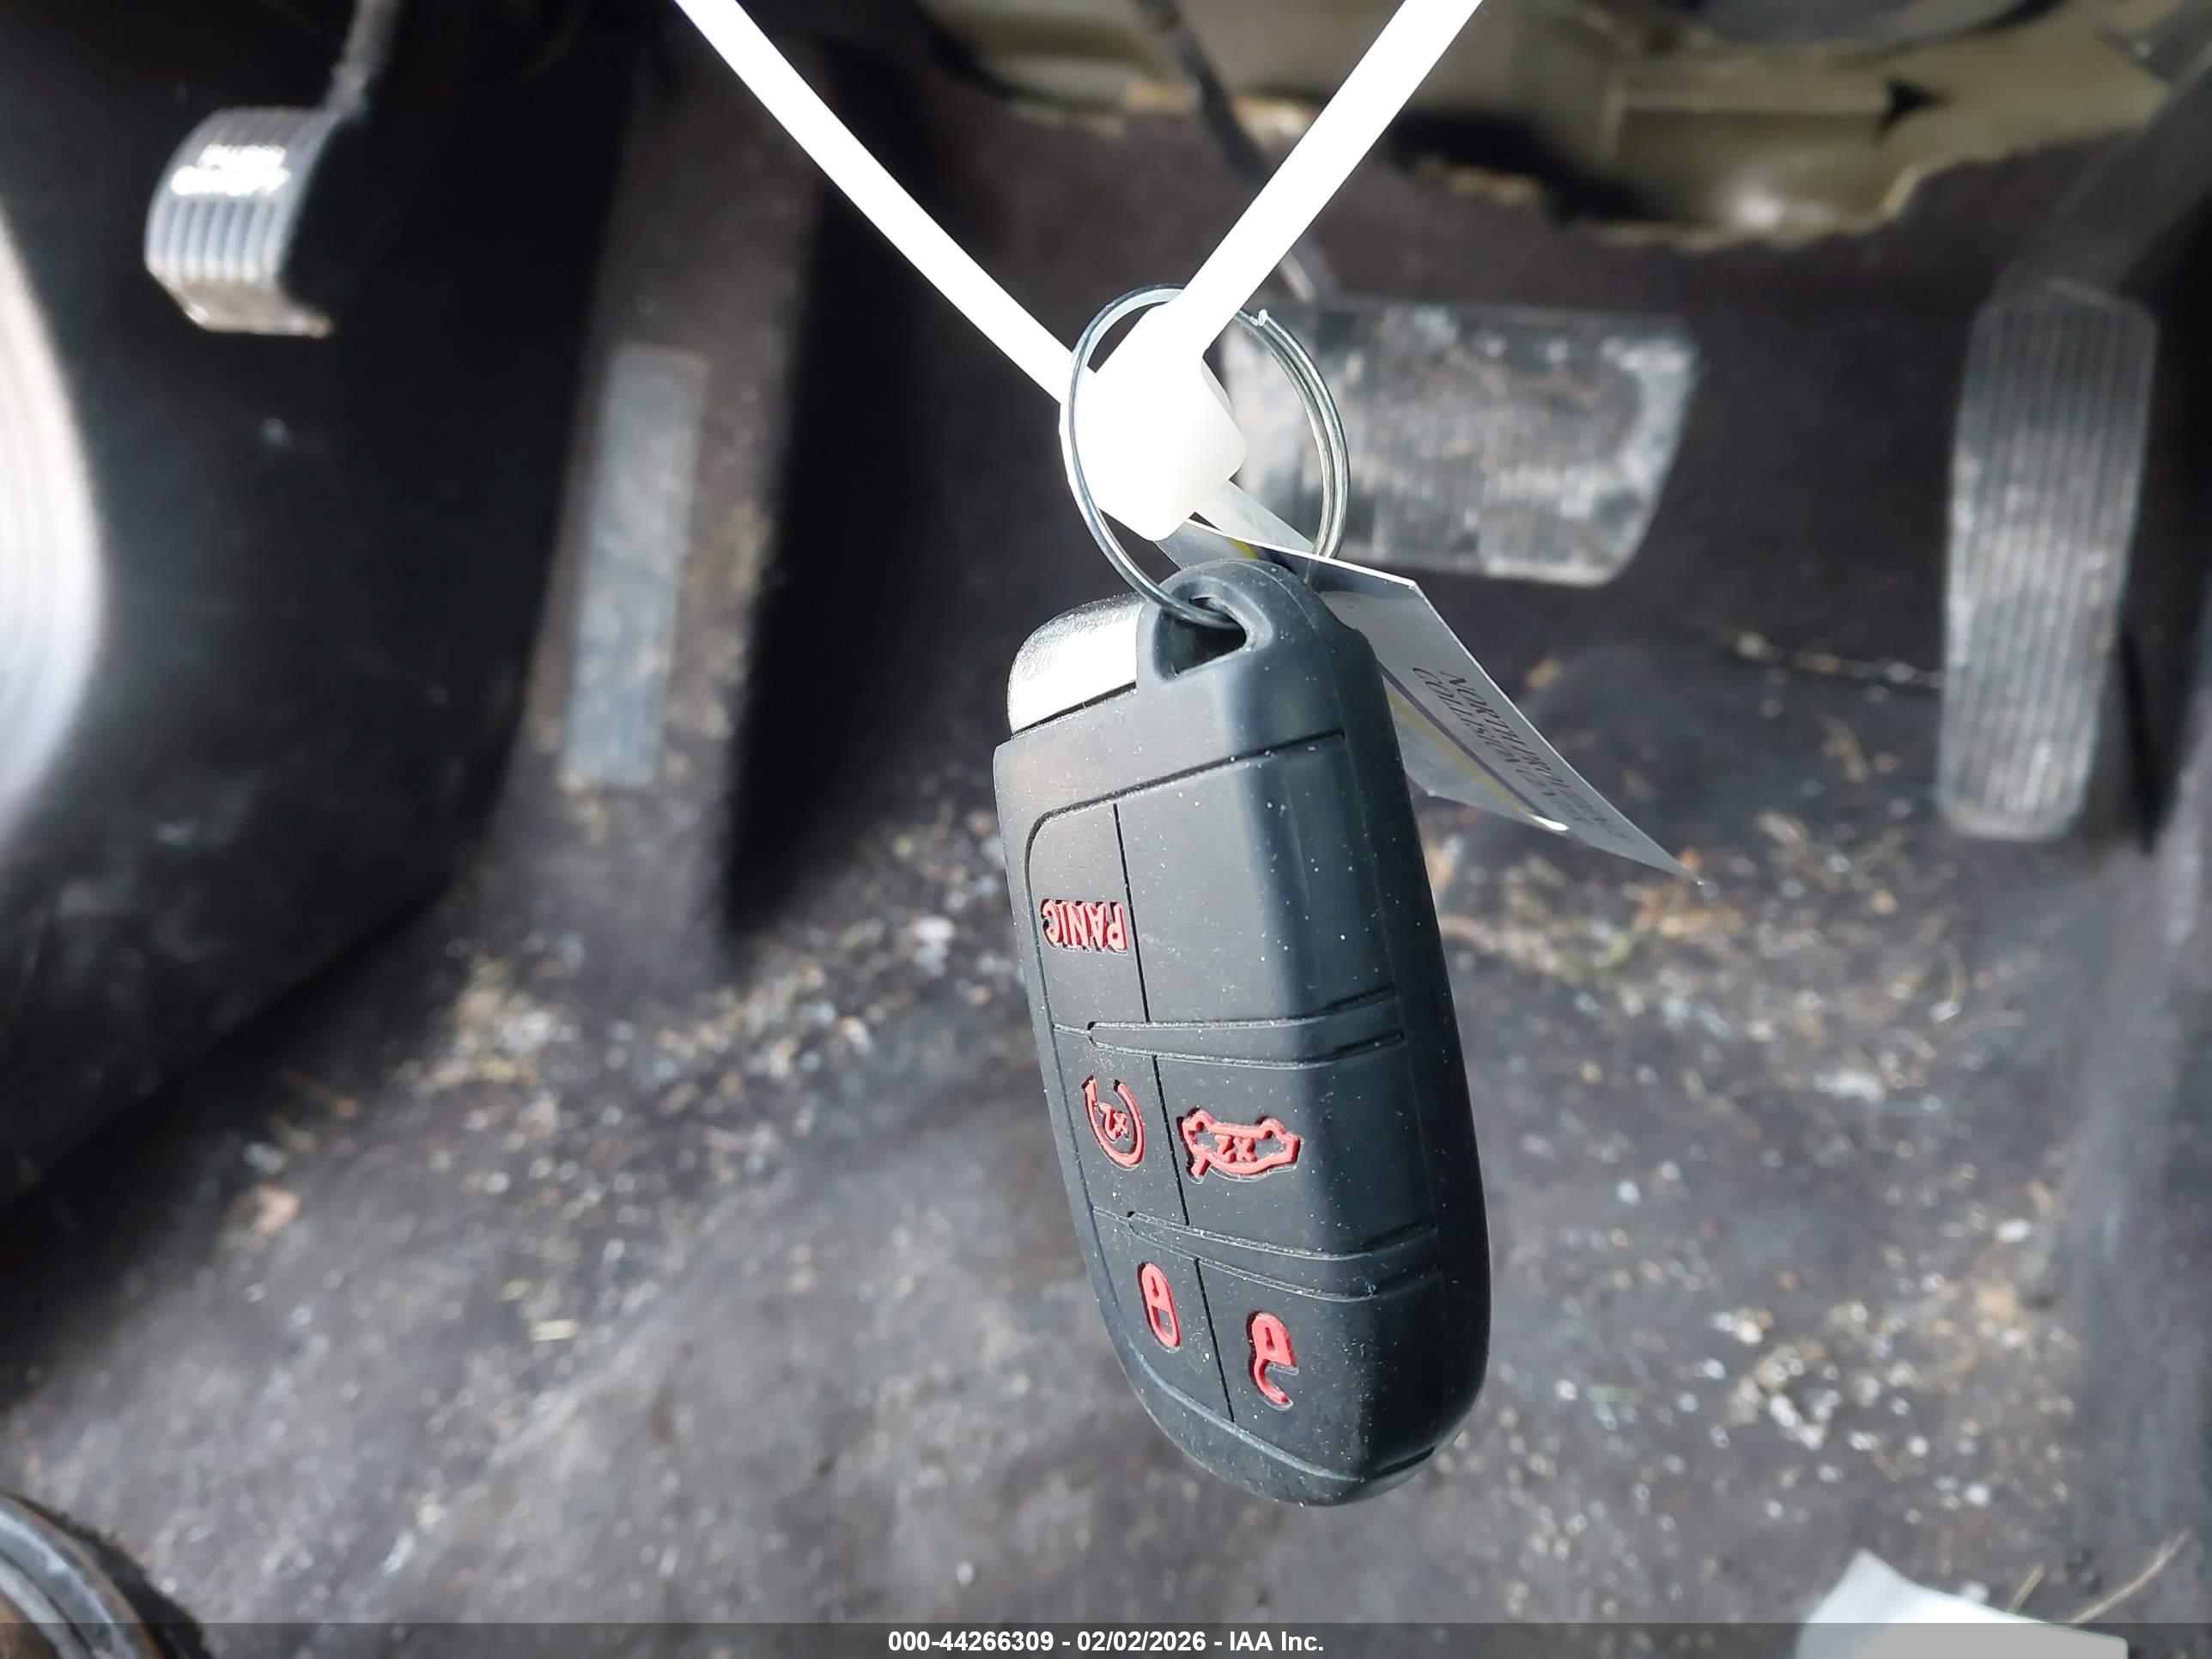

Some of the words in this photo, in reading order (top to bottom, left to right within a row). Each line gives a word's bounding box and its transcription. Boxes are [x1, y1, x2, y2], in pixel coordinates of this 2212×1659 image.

[1413, 667, 1528, 769] COLLISION
[1440, 671, 1526, 745] NORTH
[1041, 897, 1128, 953] PANIC
